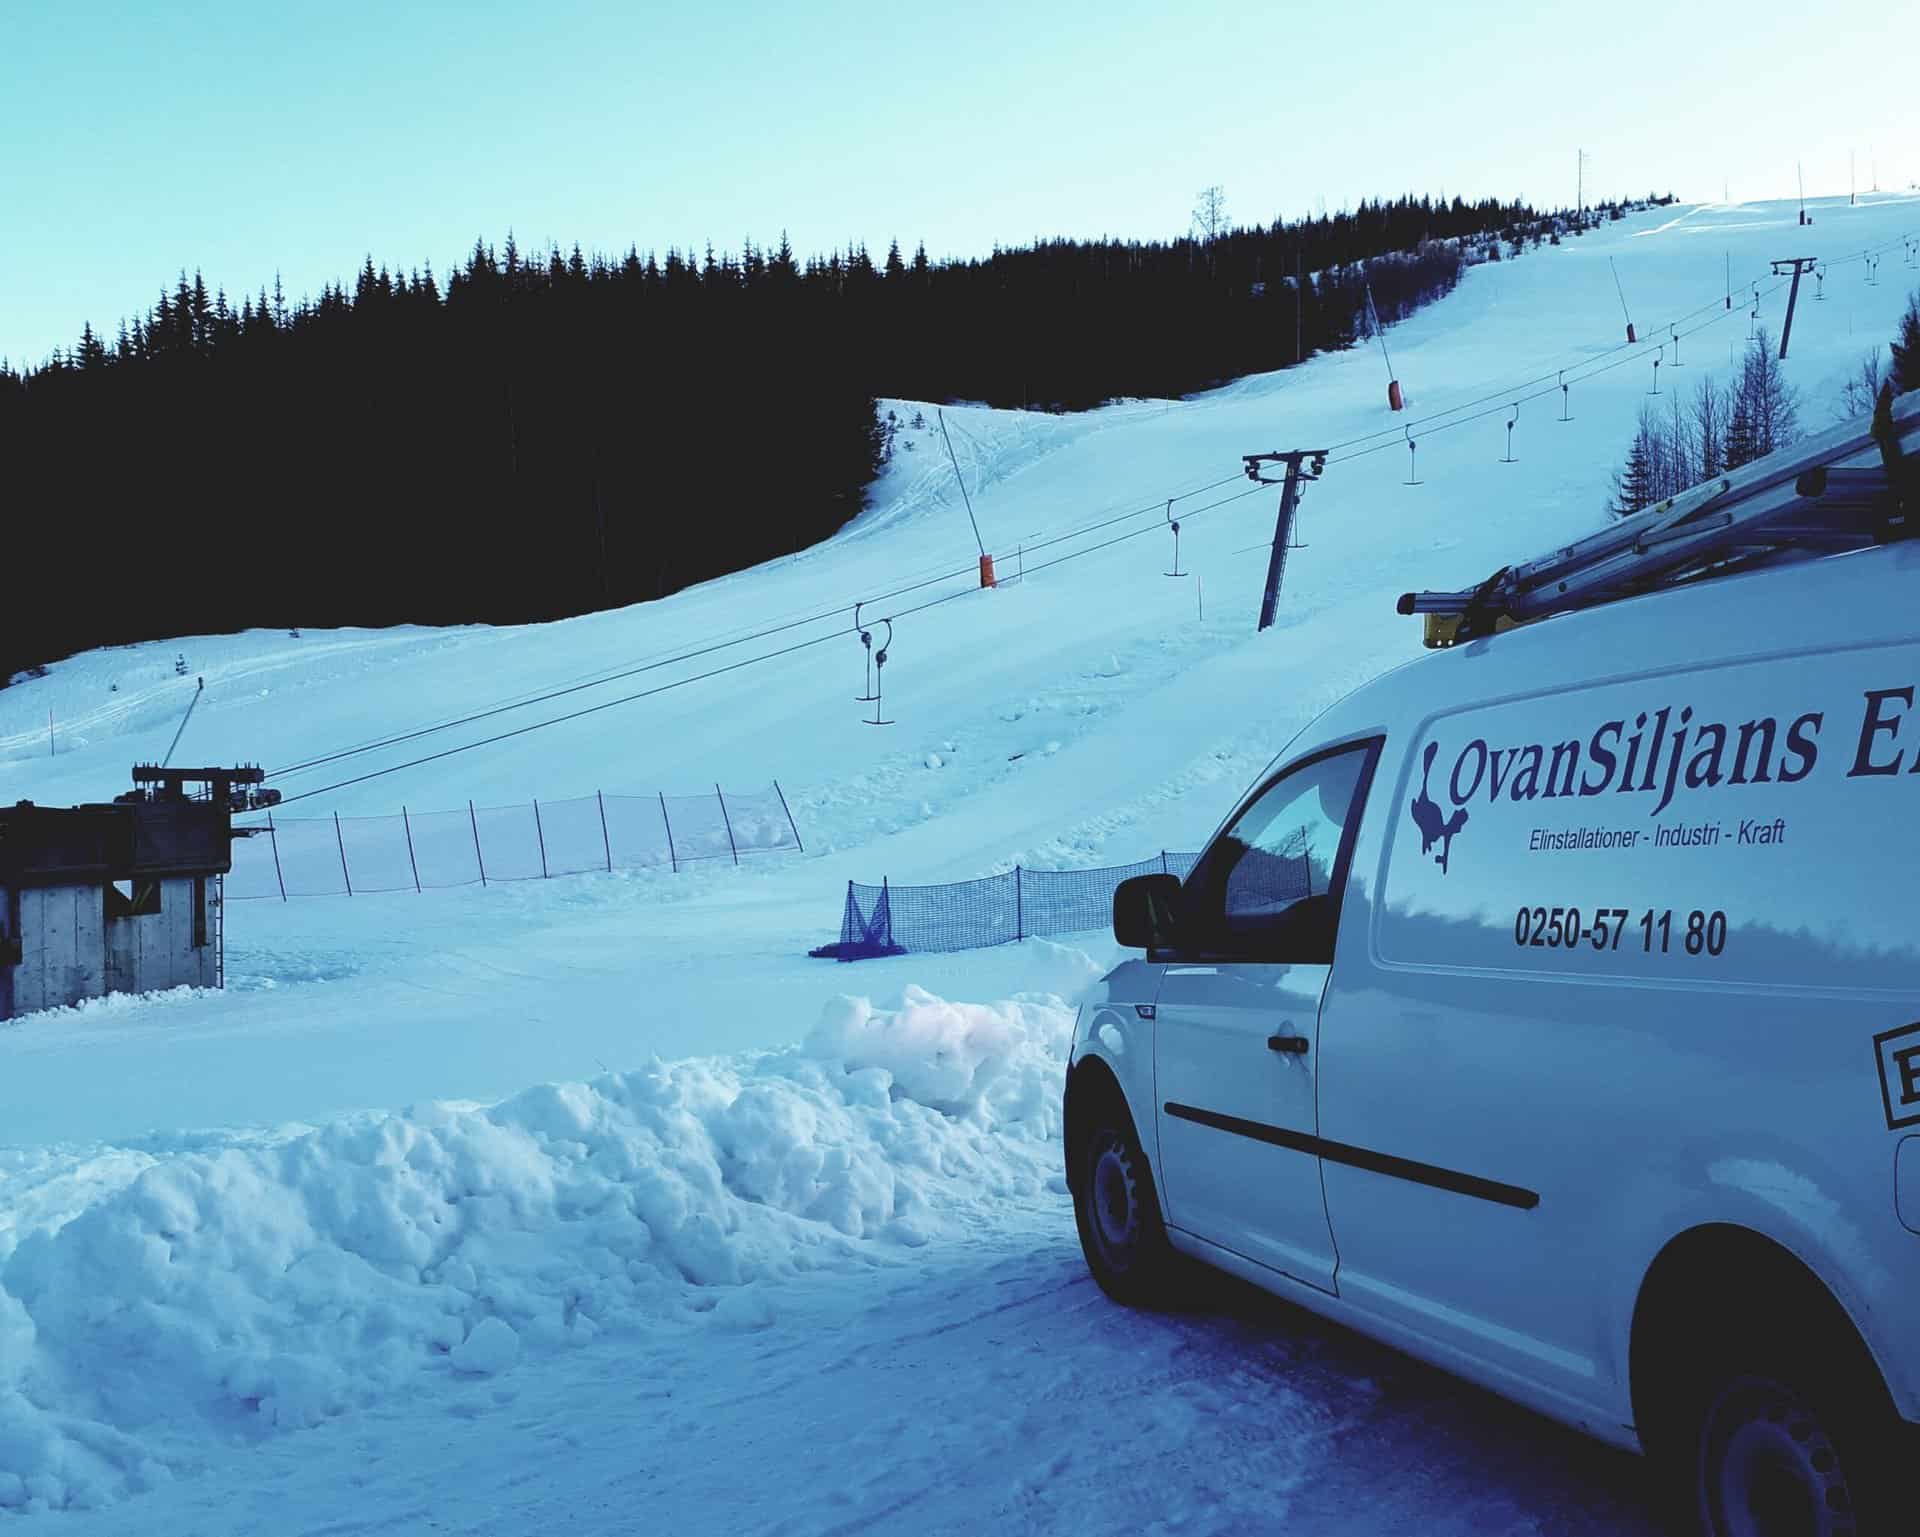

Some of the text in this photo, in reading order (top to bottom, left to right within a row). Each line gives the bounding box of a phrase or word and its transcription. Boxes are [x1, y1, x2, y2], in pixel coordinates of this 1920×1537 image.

[1449, 685, 1920, 817] OvanSiljans E
[1529, 827, 1641, 851] Elinstallationer
[1654, 823, 1720, 847] Industri
[1737, 817, 1786, 845] Kraft
[1514, 906, 1727, 957] 0250-57 11 80
